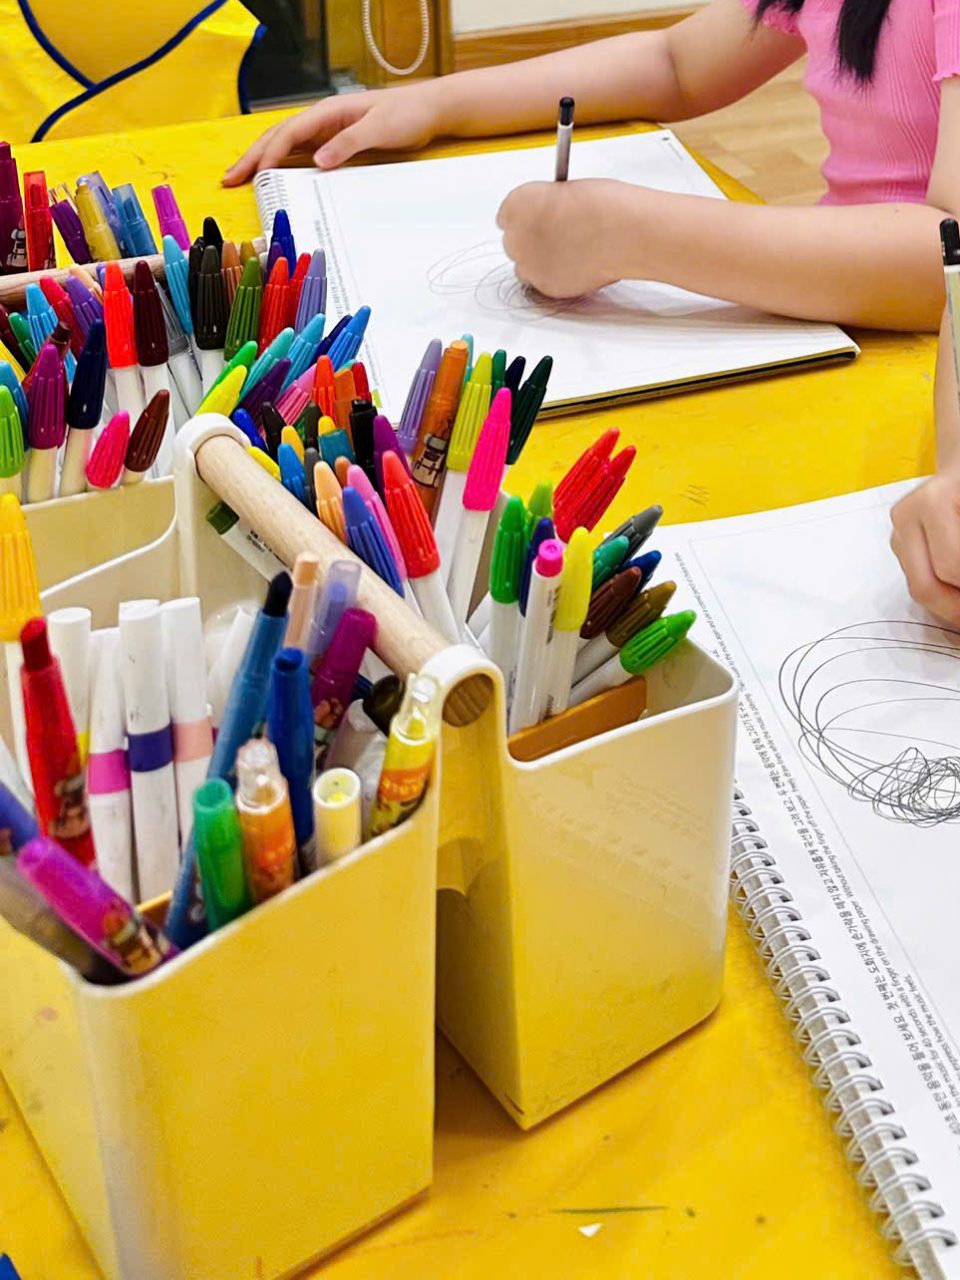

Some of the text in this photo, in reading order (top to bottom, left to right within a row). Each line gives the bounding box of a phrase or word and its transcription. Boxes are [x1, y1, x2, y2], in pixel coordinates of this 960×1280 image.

[802, 809, 813, 820] the
[796, 826, 815, 849] 곡선을
[811, 826, 829, 845] finger
[820, 844, 832, 855] the
[825, 853, 844, 874] taking
[834, 872, 854, 898] Without
[838, 909, 863, 941] 손가락을
[858, 917, 882, 945] drawing
[854, 941, 880, 974] 도화지에
[871, 944, 885, 956] the
[877, 956, 890, 966] on
[882, 965, 904, 987] finger
[870, 973, 894, 1000] 번째는
[896, 992, 912, 1008] with
[910, 991, 930, 1013] music
[904, 1007, 927, 1037] seconds
[922, 1013, 936, 1026] the
[905, 1042, 925, 1061] 들어
[919, 1037, 933, 1048] 40
[925, 1048, 939, 1060] for
[915, 1062, 941, 1090] 음악을
[931, 1060, 952, 1083] music
[943, 1083, 959, 1097] the
[930, 1091, 952, 1111] 동안
